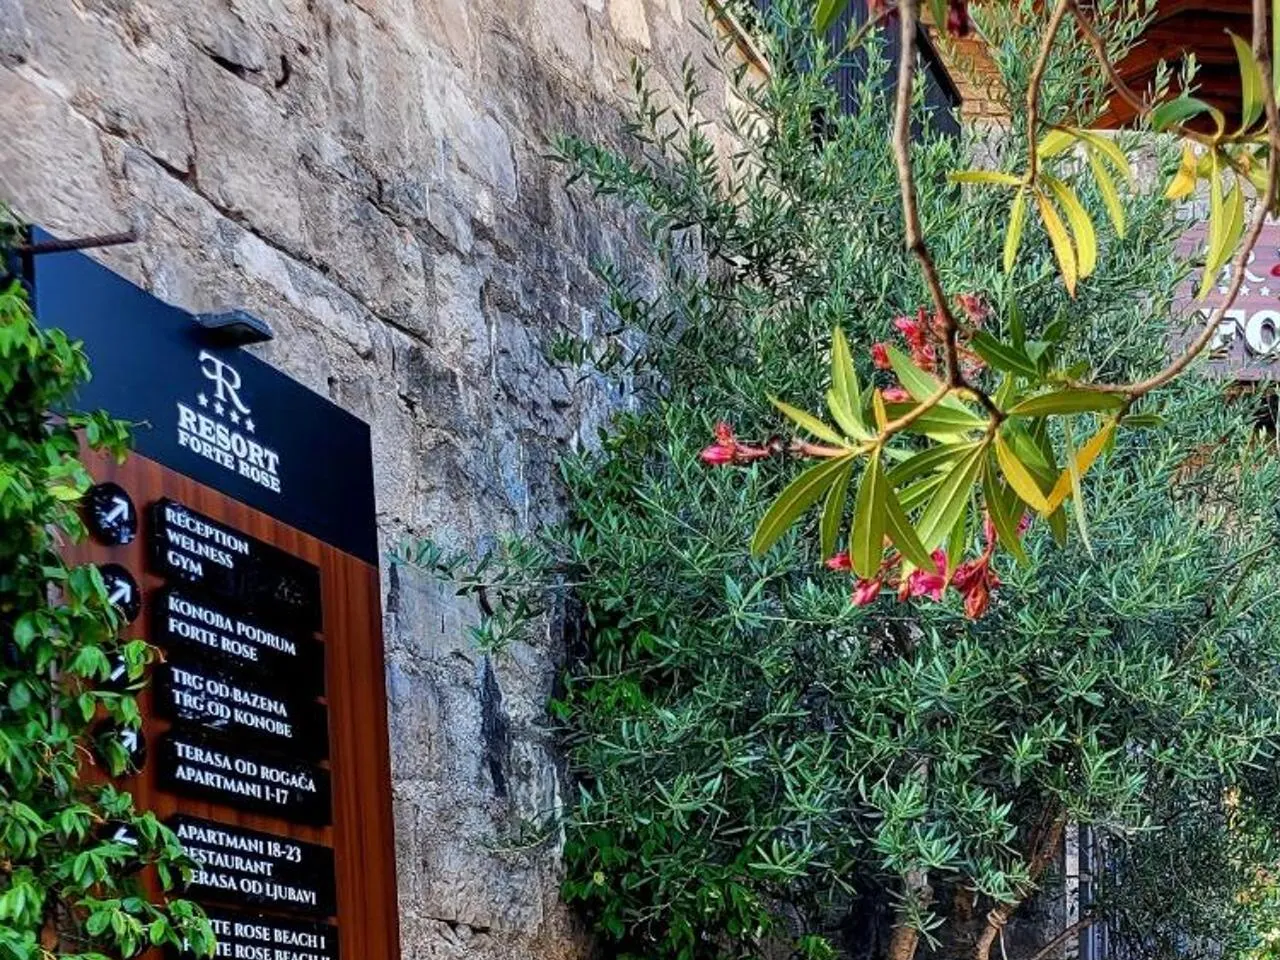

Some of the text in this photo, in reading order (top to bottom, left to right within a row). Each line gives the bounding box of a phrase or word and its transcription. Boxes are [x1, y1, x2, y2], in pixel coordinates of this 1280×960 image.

[177, 402, 280, 475] RESORT
[177, 427, 281, 493] FORTE ROSE
[165, 507, 249, 555] RECEPTION
[166, 528, 234, 569] WELNESS
[167, 550, 203, 577] GYM
[168, 596, 297, 656] KONOBA PODRUM
[168, 617, 258, 662] FORTE ROSE
[171, 667, 288, 718] TRG OD BAZENA
[172, 689, 293, 738] TRG OD KONOBE
[174, 742, 317, 793] TERASA OD ROGAČA
[176, 765, 290, 805] APARTMANI 1-17
[177, 824, 302, 863] APARTMANI 18-23
[183, 868, 317, 906] ERASA OD LJUBAVI
[183, 937, 232, 957] FTE
[234, 922, 271, 941] ROSE
[274, 928, 318, 949] BEACH
[320, 936, 326, 950] I
